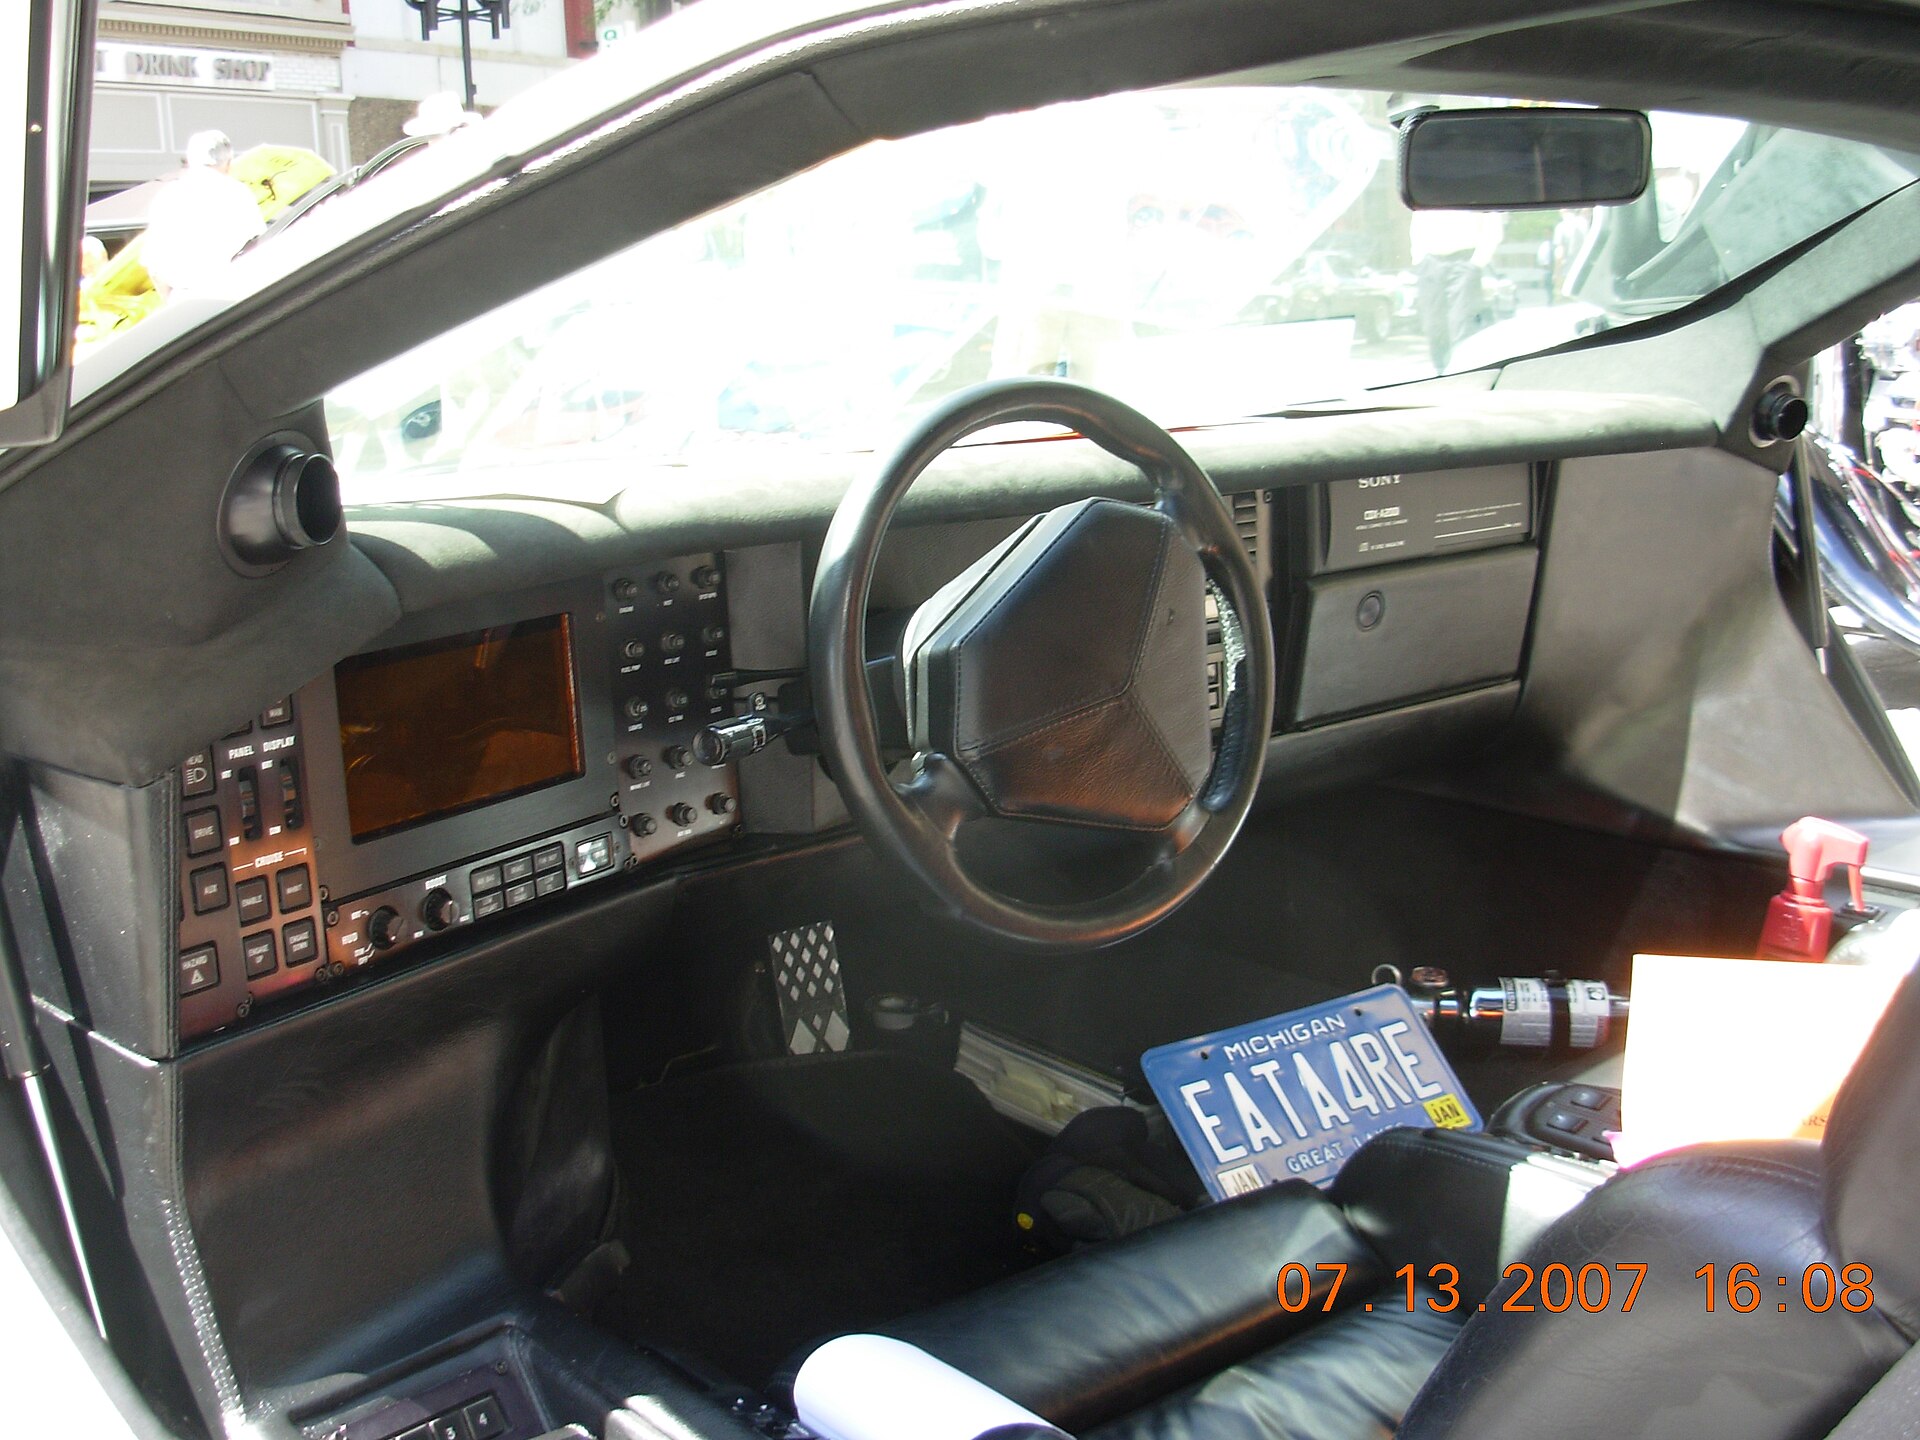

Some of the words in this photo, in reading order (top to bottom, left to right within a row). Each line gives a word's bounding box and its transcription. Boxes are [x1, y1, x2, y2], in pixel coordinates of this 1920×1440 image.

[126, 52, 199, 78] DRINK
[213, 57, 271, 82] SHOP
[1358, 474, 1401, 489] SONY
[263, 735, 296, 752] DISPLAY
[228, 745, 255, 760] PANEL
[194, 825, 216, 839] DRIVE
[255, 850, 285, 868] CRUISE
[182, 954, 209, 970] HAZARD
[1223, 1014, 1347, 1062] MICHIGAN
[1180, 1021, 1443, 1164] EATA4RE
[1433, 1103, 1461, 1123] JAN
[1286, 1142, 1346, 1174] GREAT
[1231, 1168, 1260, 1192] JAN
[479, 1412, 488, 1425] 4
[446, 1426, 456, 1440] 3
